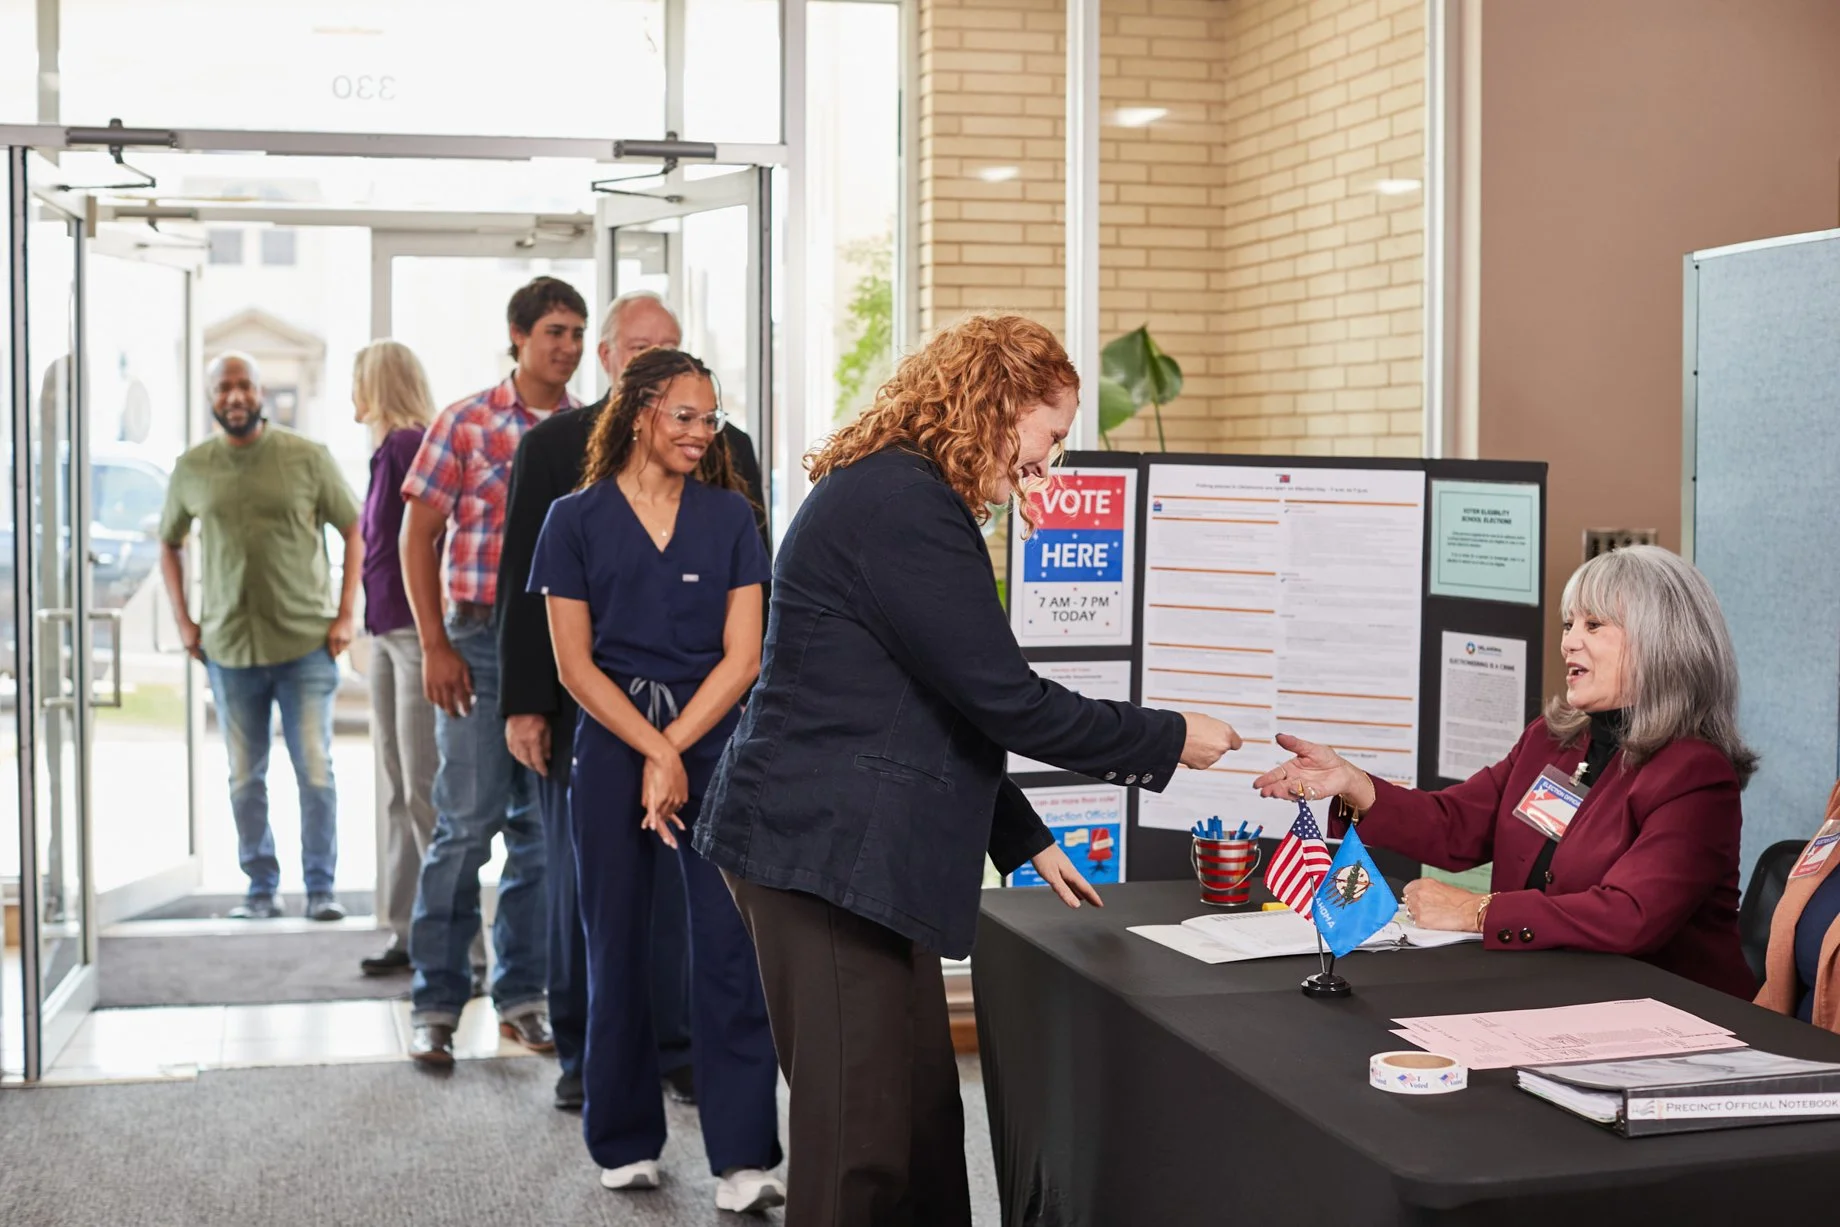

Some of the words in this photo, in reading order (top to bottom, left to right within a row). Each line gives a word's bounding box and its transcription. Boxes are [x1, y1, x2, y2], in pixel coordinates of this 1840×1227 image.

[1040, 489, 1112, 514] VOTE
[1041, 543, 1109, 568] HERE
[1039, 597, 1046, 608] 7
[1050, 597, 1070, 607] AM
[1081, 597, 1087, 607] 7
[1091, 597, 1109, 607] PM
[1052, 611, 1097, 622] TODAY
[1542, 781, 1565, 798] ELECTION
[1045, 811, 1082, 823] Election
[1084, 809, 1118, 820] Official
[1666, 1102, 1721, 1113] PRECINCT
[1724, 1099, 1776, 1111] OFFICIAL
[1778, 1098, 1839, 1109] NOTEBOOK
